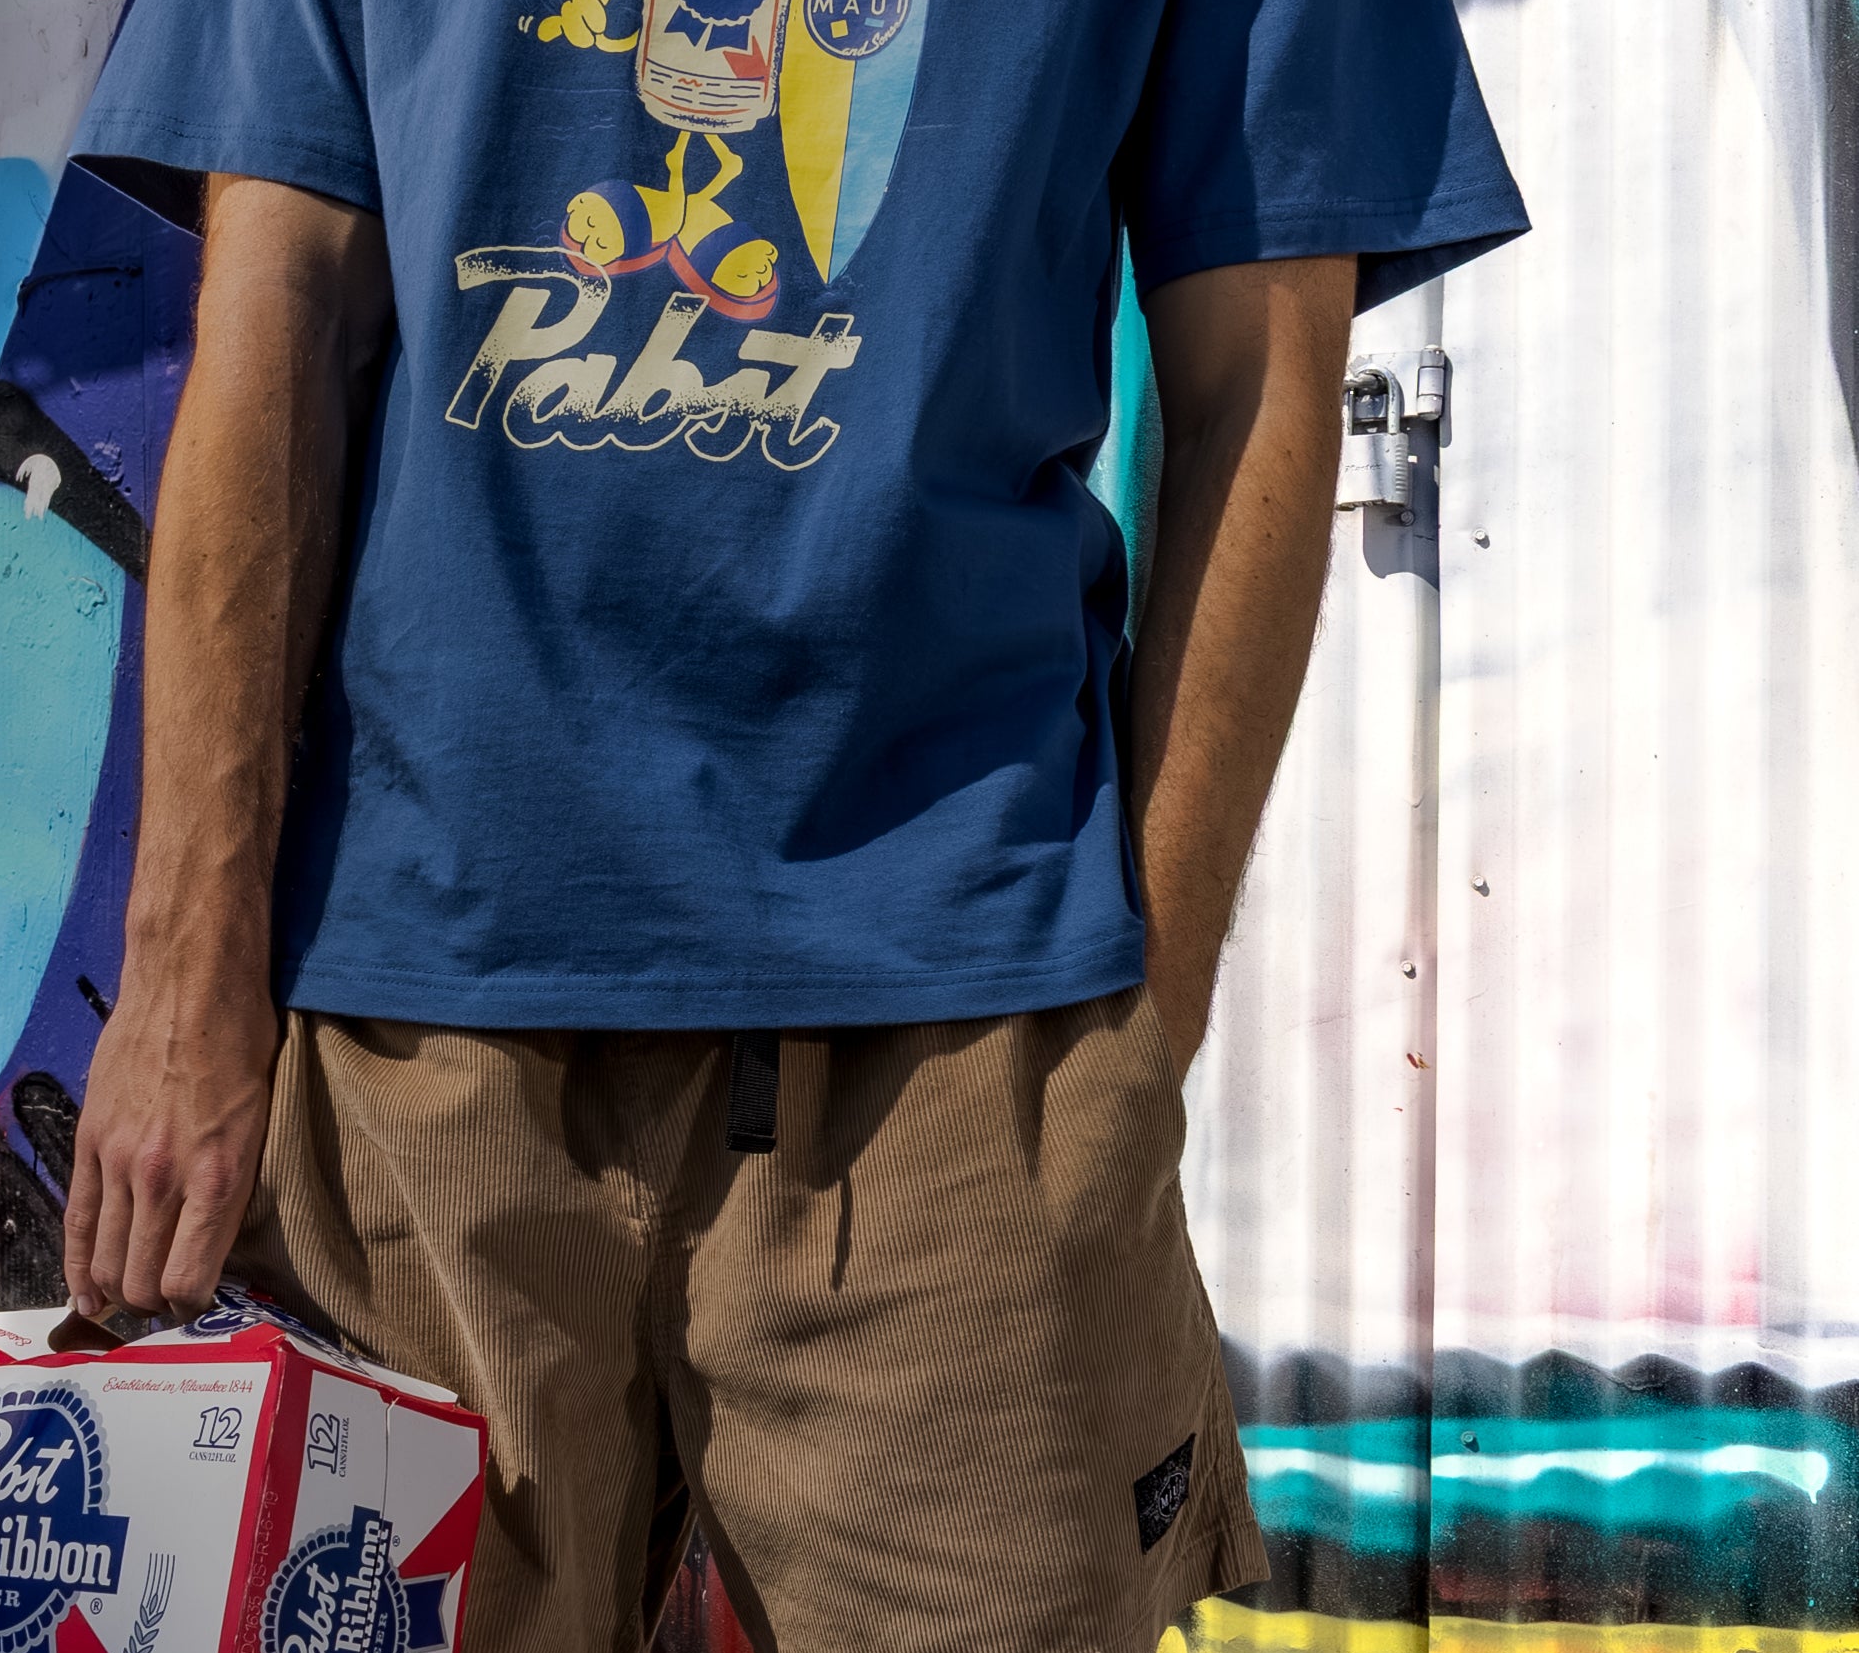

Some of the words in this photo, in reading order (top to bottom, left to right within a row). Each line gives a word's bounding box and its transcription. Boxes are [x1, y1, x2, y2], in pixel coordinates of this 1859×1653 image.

[841, 40, 869, 56] and
[445, 245, 862, 471] Pabst
[103, 1377, 162, 1393] Established
[163, 1381, 176, 1394] in
[174, 1379, 228, 1394] Milwaukee
[228, 1380, 253, 1393] 1844
[193, 1406, 242, 1449] 12
[306, 1411, 341, 1475] 12
